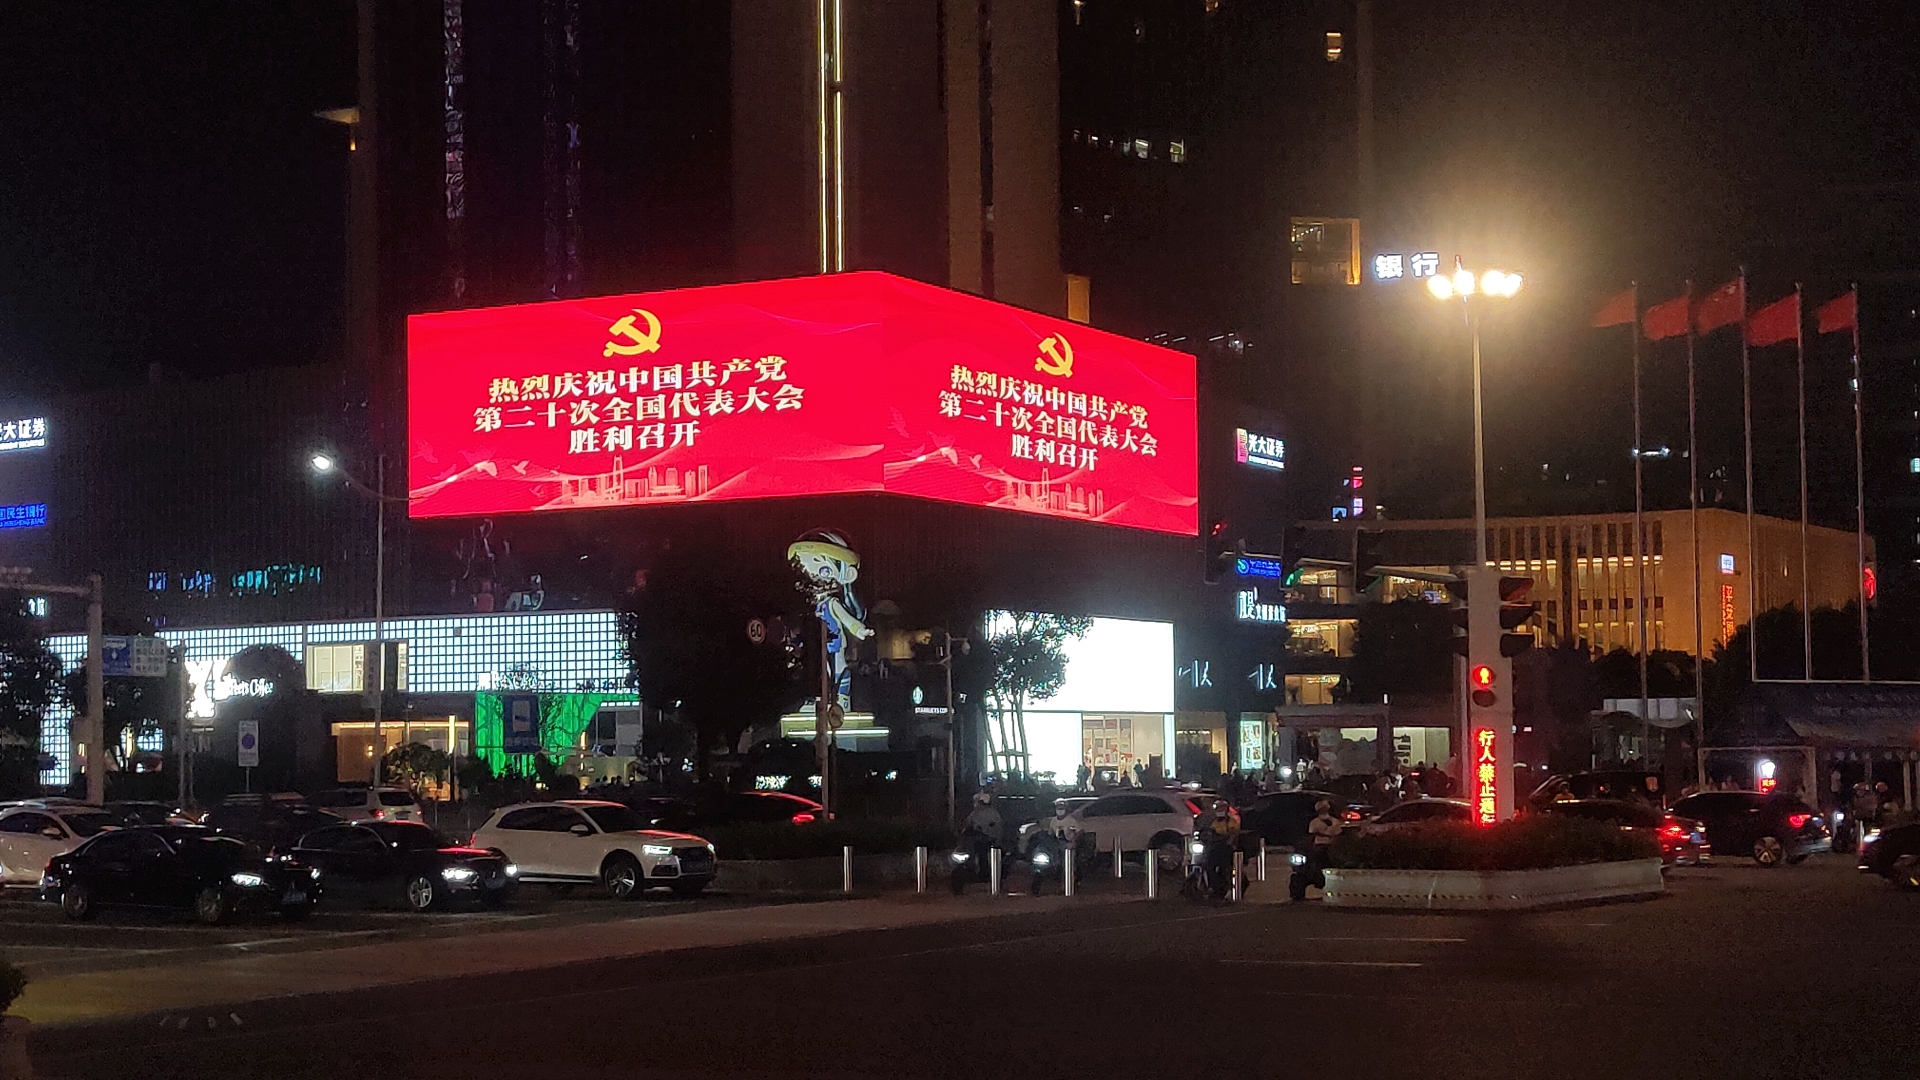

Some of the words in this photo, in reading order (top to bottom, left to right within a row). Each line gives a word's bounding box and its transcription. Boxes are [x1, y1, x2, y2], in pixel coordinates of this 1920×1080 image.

[1375, 254, 1439, 279] 银行
[488, 355, 787, 404] 热烈庆祝中国共产党
[950, 365, 1148, 429] 热烈庆祝中国共产党
[473, 383, 805, 433] 第二十次全国代表大会
[938, 390, 1157, 457] 第二十次全国代表大会
[568, 420, 701, 454] 胜利召开
[1011, 433, 1099, 471] 胜利召开
[1248, 433, 1285, 458] 光大证券
